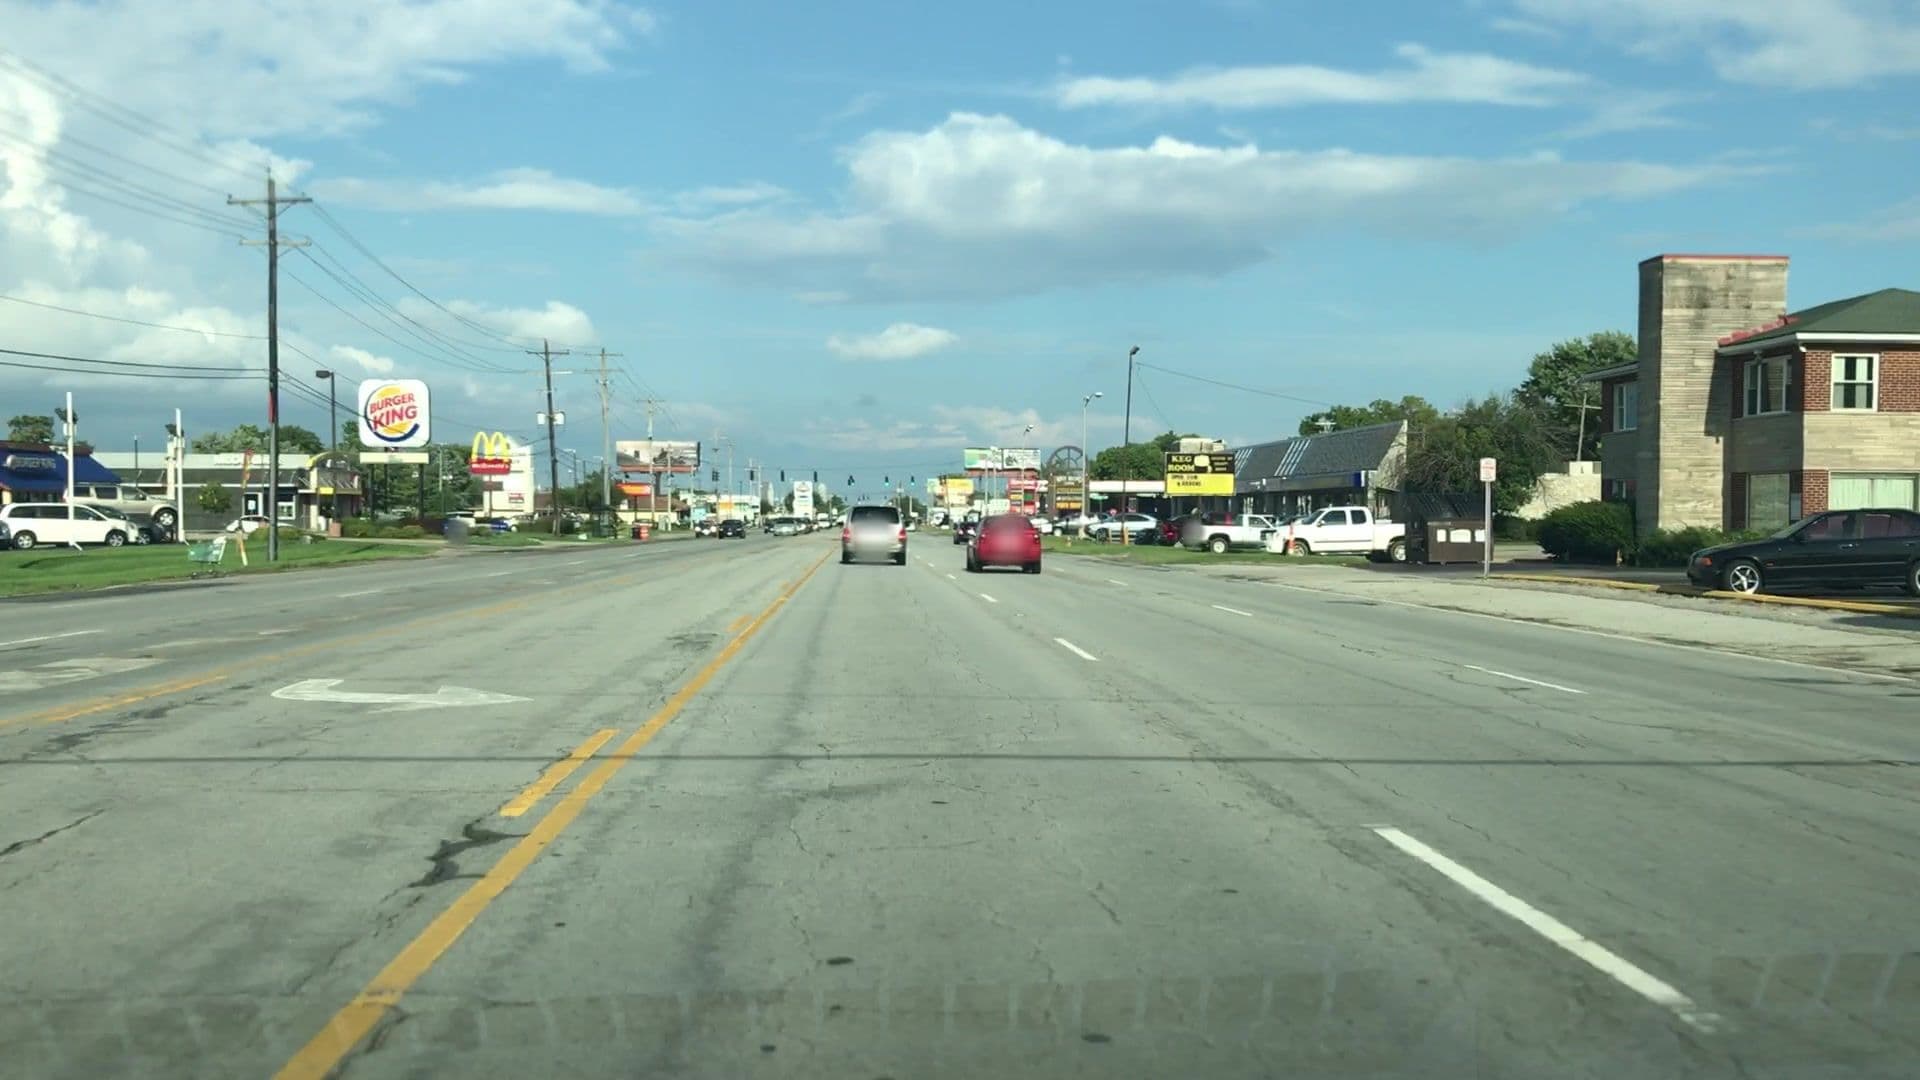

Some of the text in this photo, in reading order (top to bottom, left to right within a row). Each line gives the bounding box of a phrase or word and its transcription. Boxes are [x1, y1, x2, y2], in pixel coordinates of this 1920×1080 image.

[369, 392, 415, 415] BURGER
[373, 405, 417, 431] KING
[1168, 464, 1195, 472] ROOM
